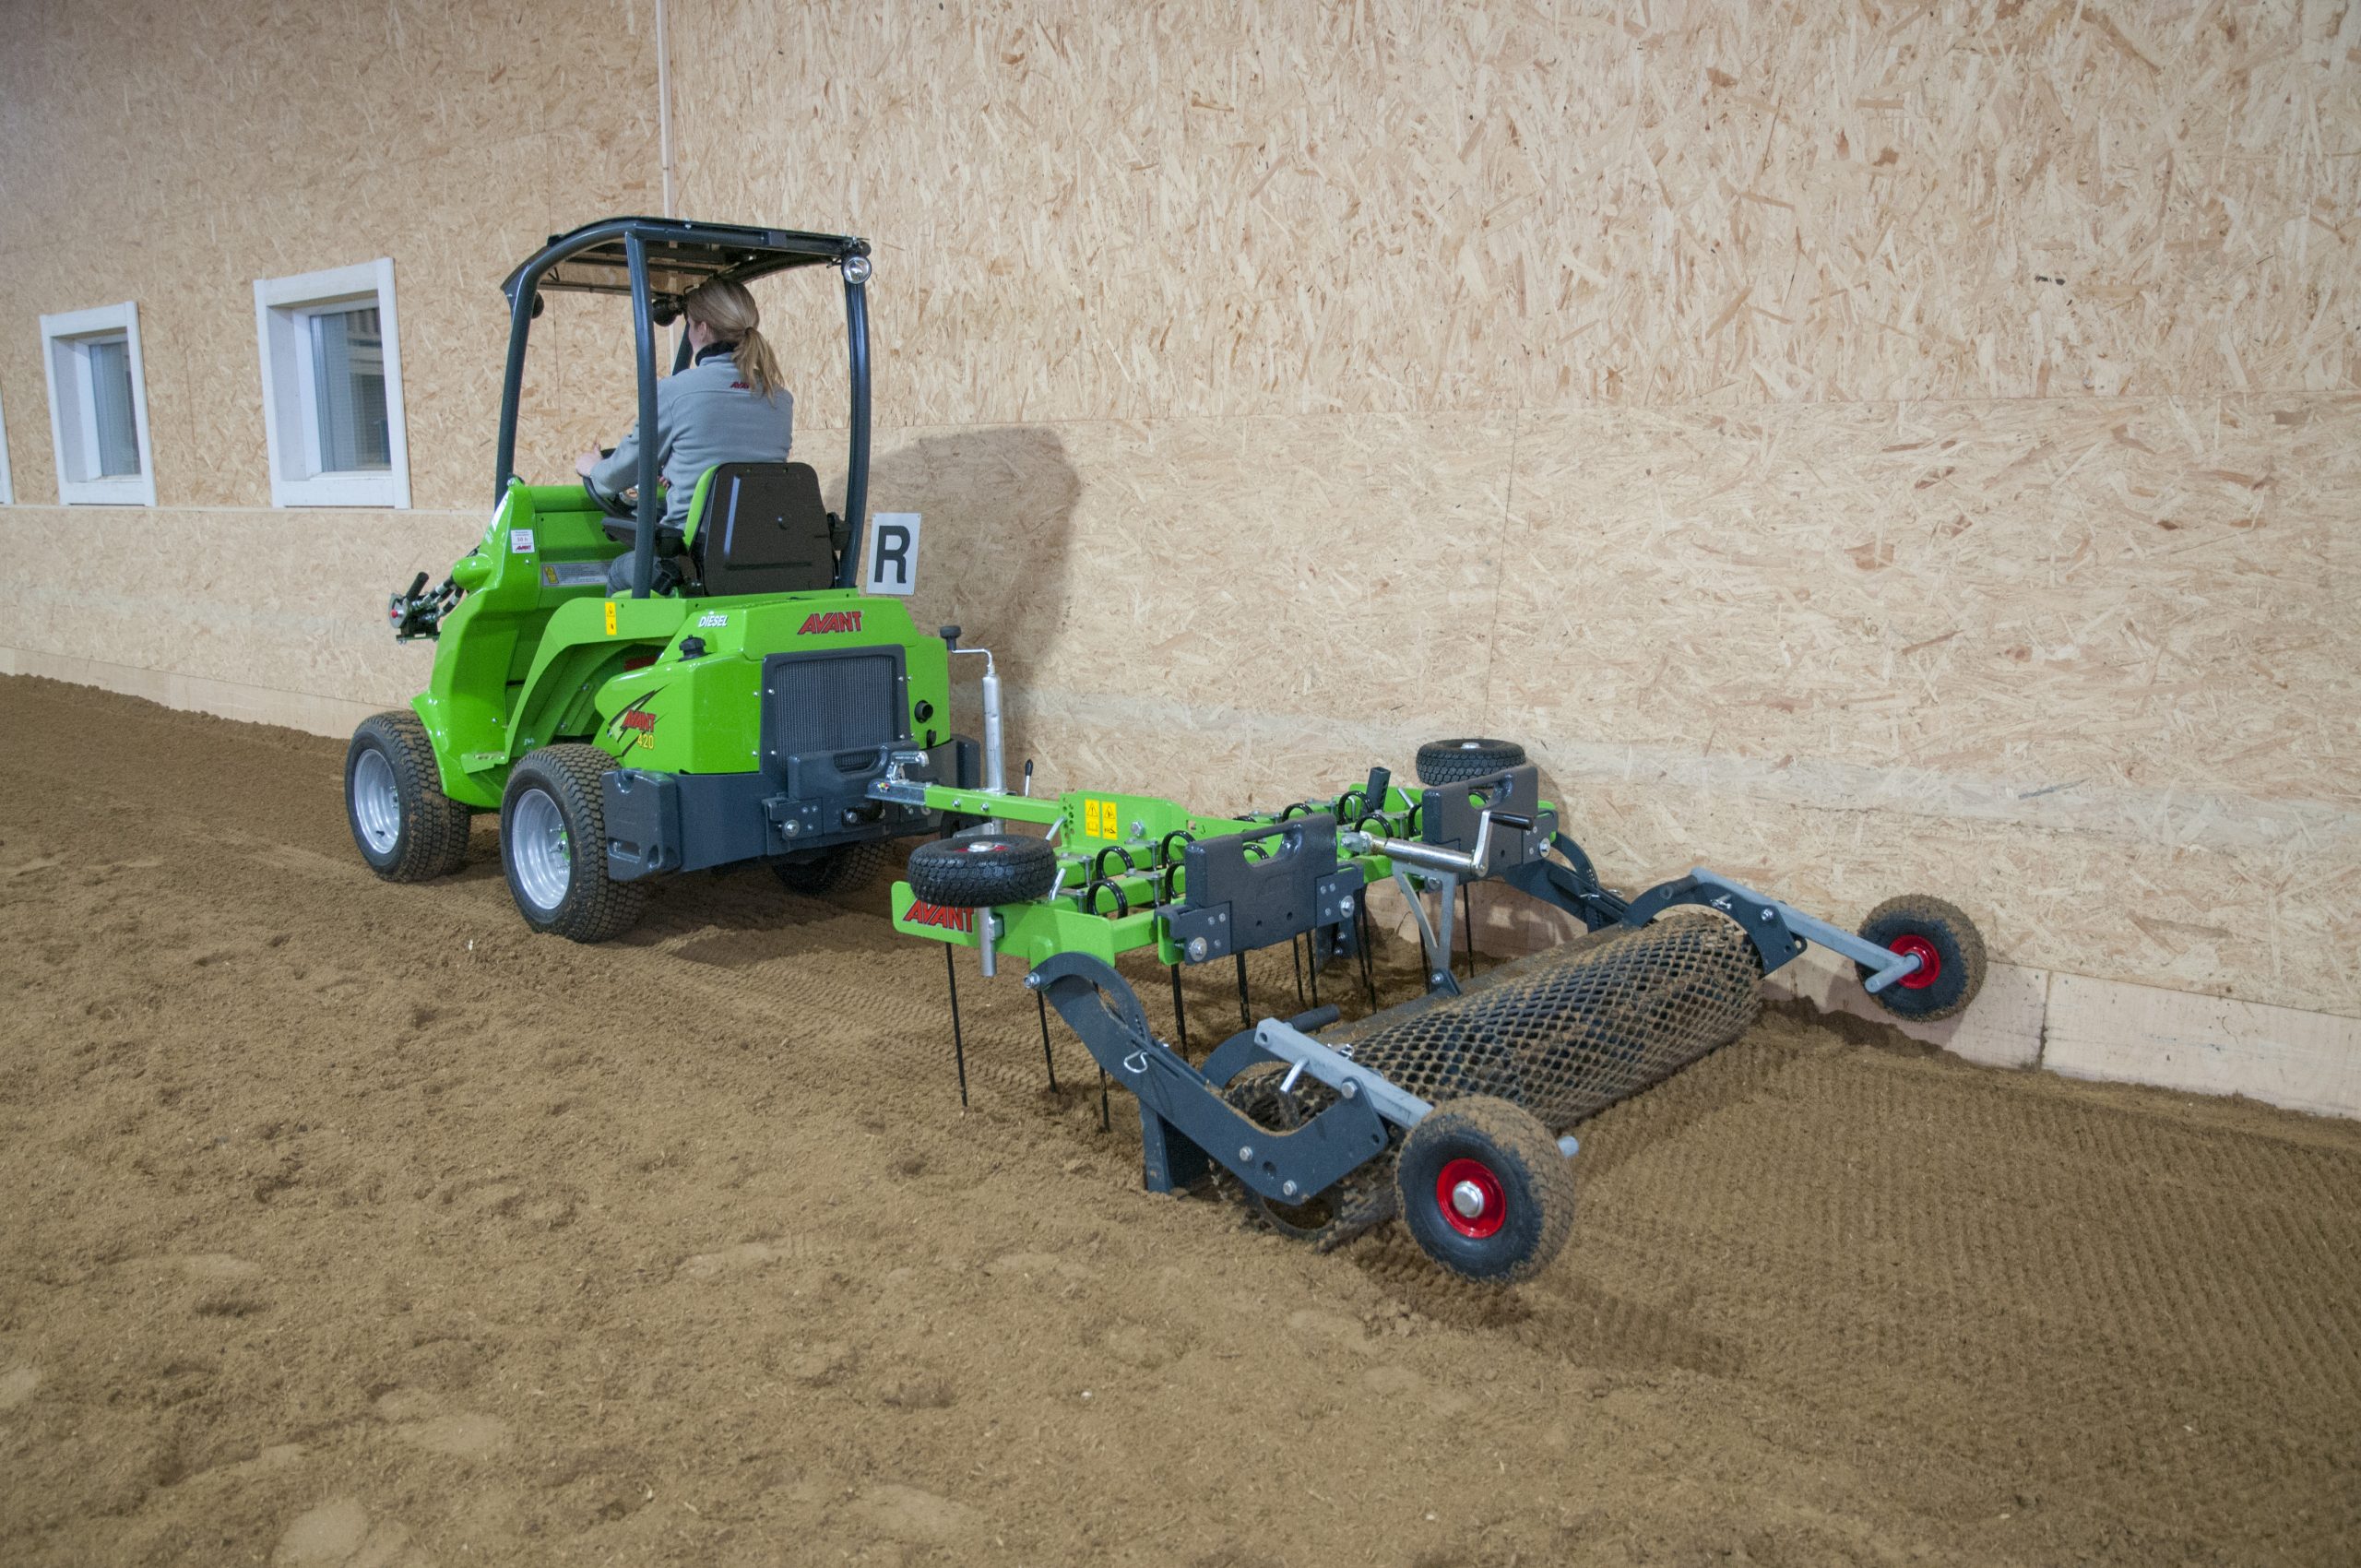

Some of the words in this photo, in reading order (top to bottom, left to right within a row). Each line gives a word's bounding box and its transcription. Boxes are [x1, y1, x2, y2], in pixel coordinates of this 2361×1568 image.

[873, 525, 911, 584] R
[698, 614, 728, 627] DIESEL
[797, 612, 862, 635] AVANT
[620, 709, 656, 732] AVANT
[637, 733, 654, 749] 420
[903, 899, 974, 932] AVANT
